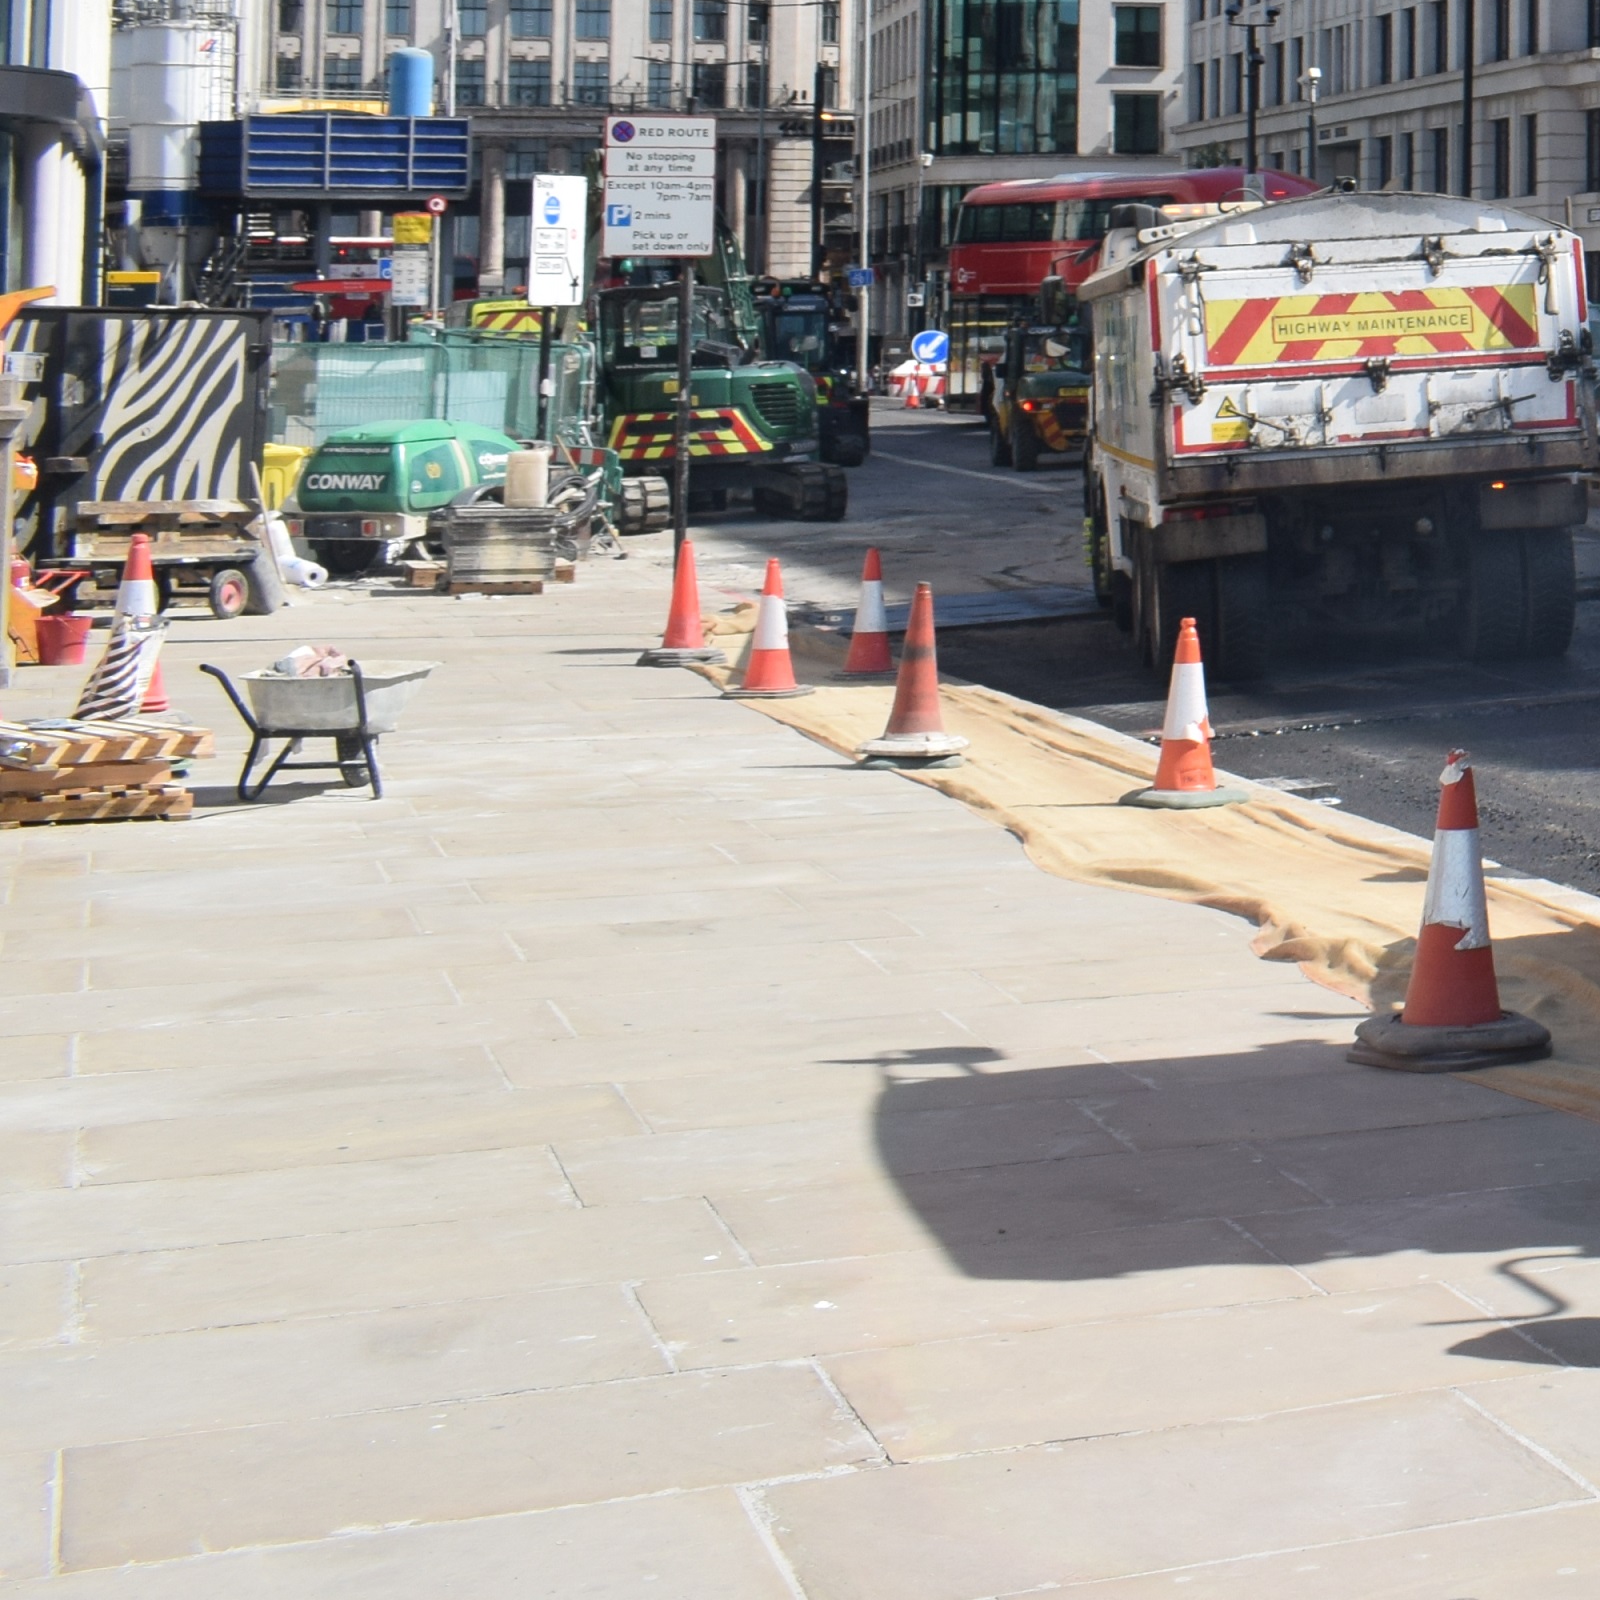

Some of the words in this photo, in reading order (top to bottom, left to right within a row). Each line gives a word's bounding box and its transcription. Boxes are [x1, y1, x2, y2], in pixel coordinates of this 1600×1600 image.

[639, 127, 665, 138] RED
[668, 128, 710, 138] ROUTE
[626, 152, 643, 161] No
[648, 152, 696, 162] stopping
[628, 164, 639, 172] at
[644, 165, 663, 173] any
[668, 164, 693, 172] time
[607, 181, 647, 190] Except
[634, 211, 643, 220] 2
[644, 211, 671, 220] mins
[632, 231, 656, 240] Pick
[660, 233, 674, 241] up
[677, 232, 689, 240] or
[632, 243, 649, 251] set
[653, 242, 680, 251] down
[687, 242, 710, 252] only
[1278, 321, 1350, 336] HIGHWAY
[1357, 314, 1470, 331] MAINTENANCE
[307, 473, 385, 491] CONWAY
